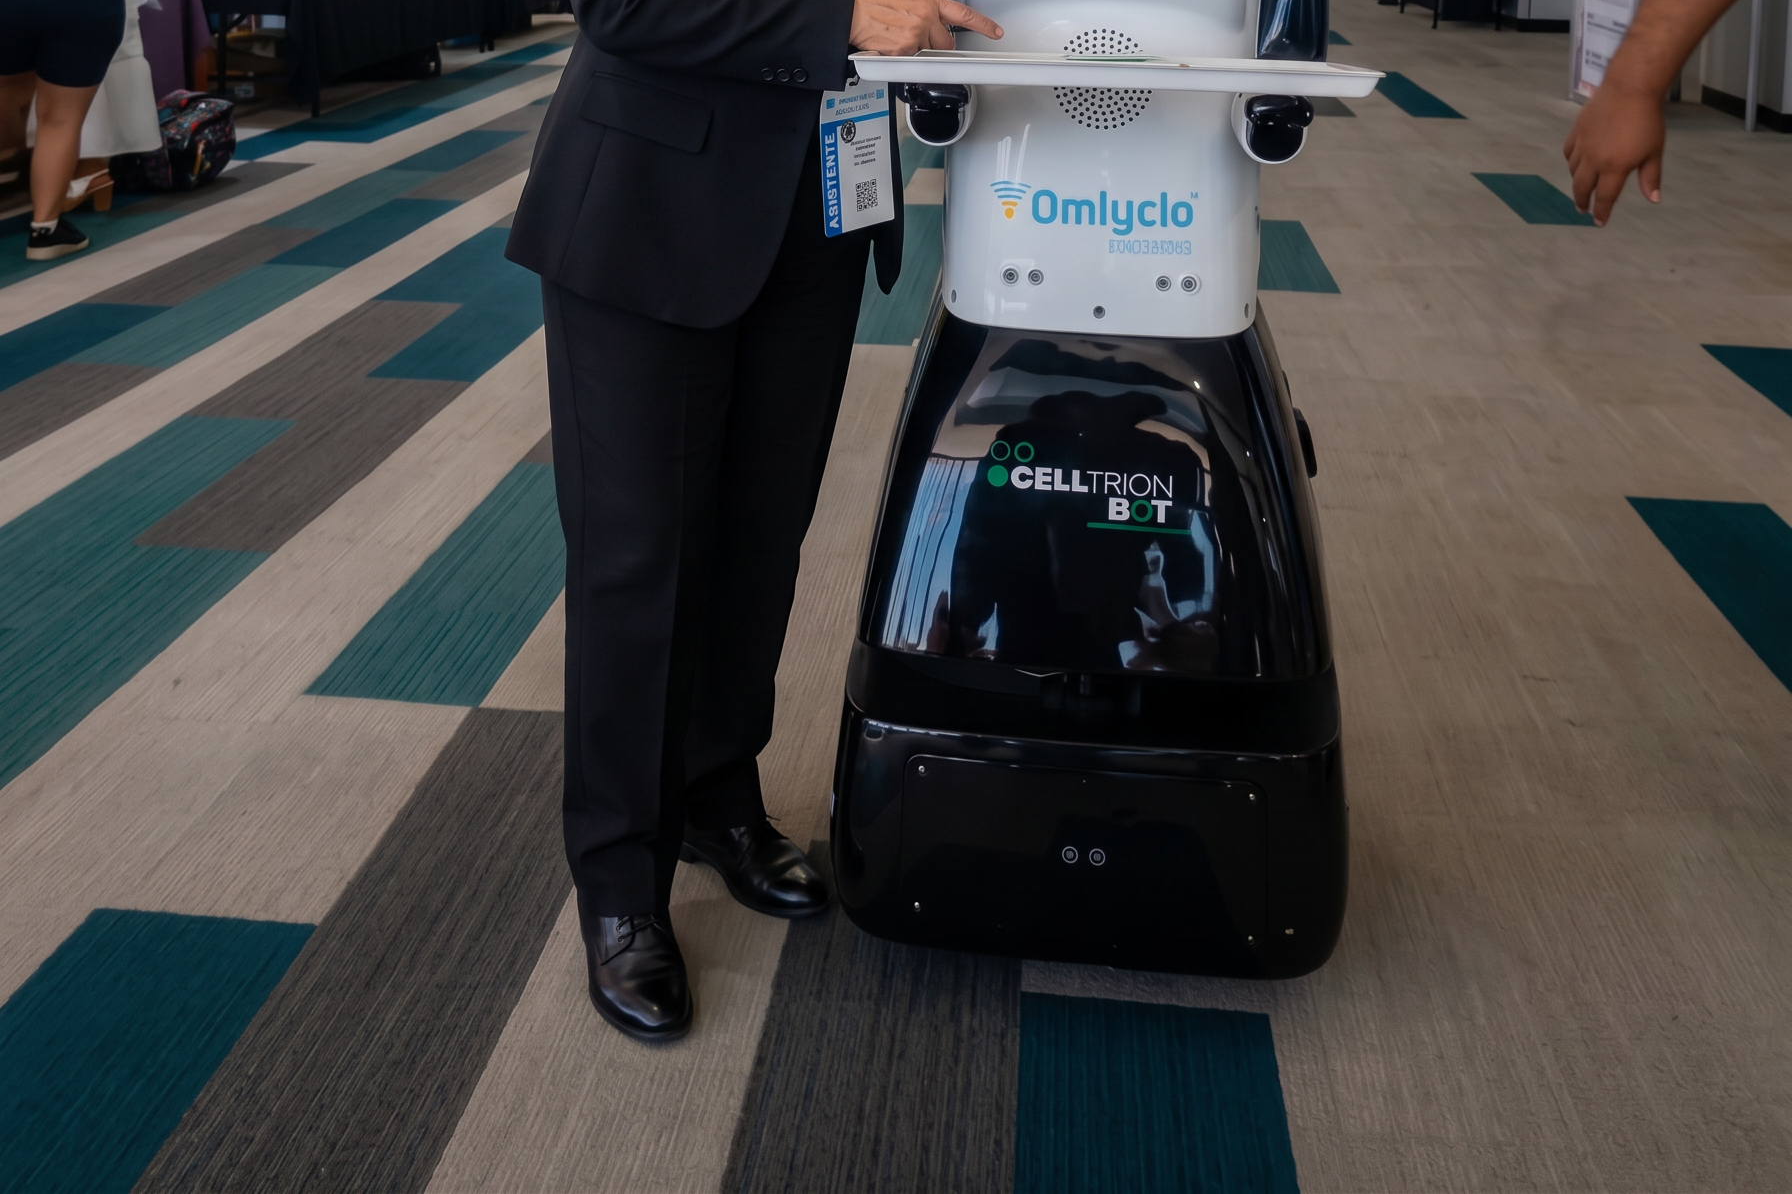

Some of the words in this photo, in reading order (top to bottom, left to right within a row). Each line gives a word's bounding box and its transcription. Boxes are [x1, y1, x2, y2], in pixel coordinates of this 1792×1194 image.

[825, 132, 840, 229] ASISTENTE
[1032, 190, 1194, 236] Omlyclo
[1010, 465, 1173, 498] CELLTRION
[1108, 497, 1173, 523] BOT
